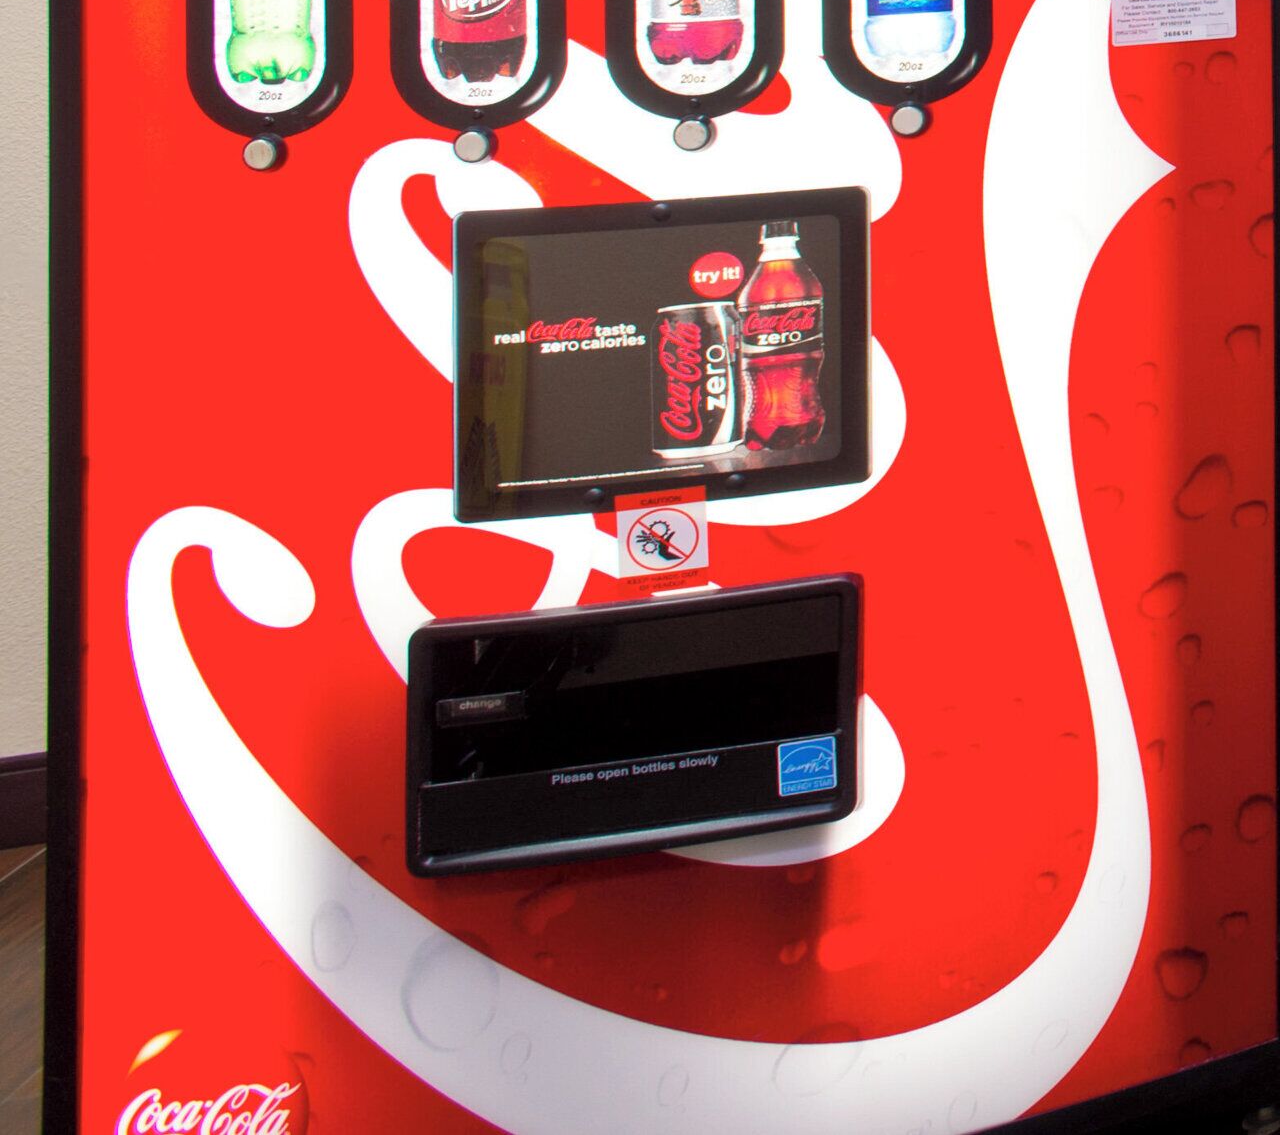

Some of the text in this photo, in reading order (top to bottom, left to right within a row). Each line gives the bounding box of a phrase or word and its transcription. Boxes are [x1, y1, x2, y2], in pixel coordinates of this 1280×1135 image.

[898, 61, 923, 73] 20oz
[680, 73, 706, 85] 20oz
[258, 90, 284, 102] 20oz
[467, 86, 493, 98] 20oz
[693, 266, 741, 285] try it!
[742, 305, 817, 337] Coca-Cola
[494, 317, 637, 345] real Coca-Cola taste
[757, 330, 802, 346] zero
[540, 334, 647, 354] zero calories
[658, 318, 703, 441] Coca-Cola
[705, 343, 727, 411] zero
[640, 495, 682, 505] CAUTION
[459, 698, 502, 711] change
[551, 754, 718, 786] Please open bottles slowly
[114, 1082, 302, 1135] Coca-Cola
